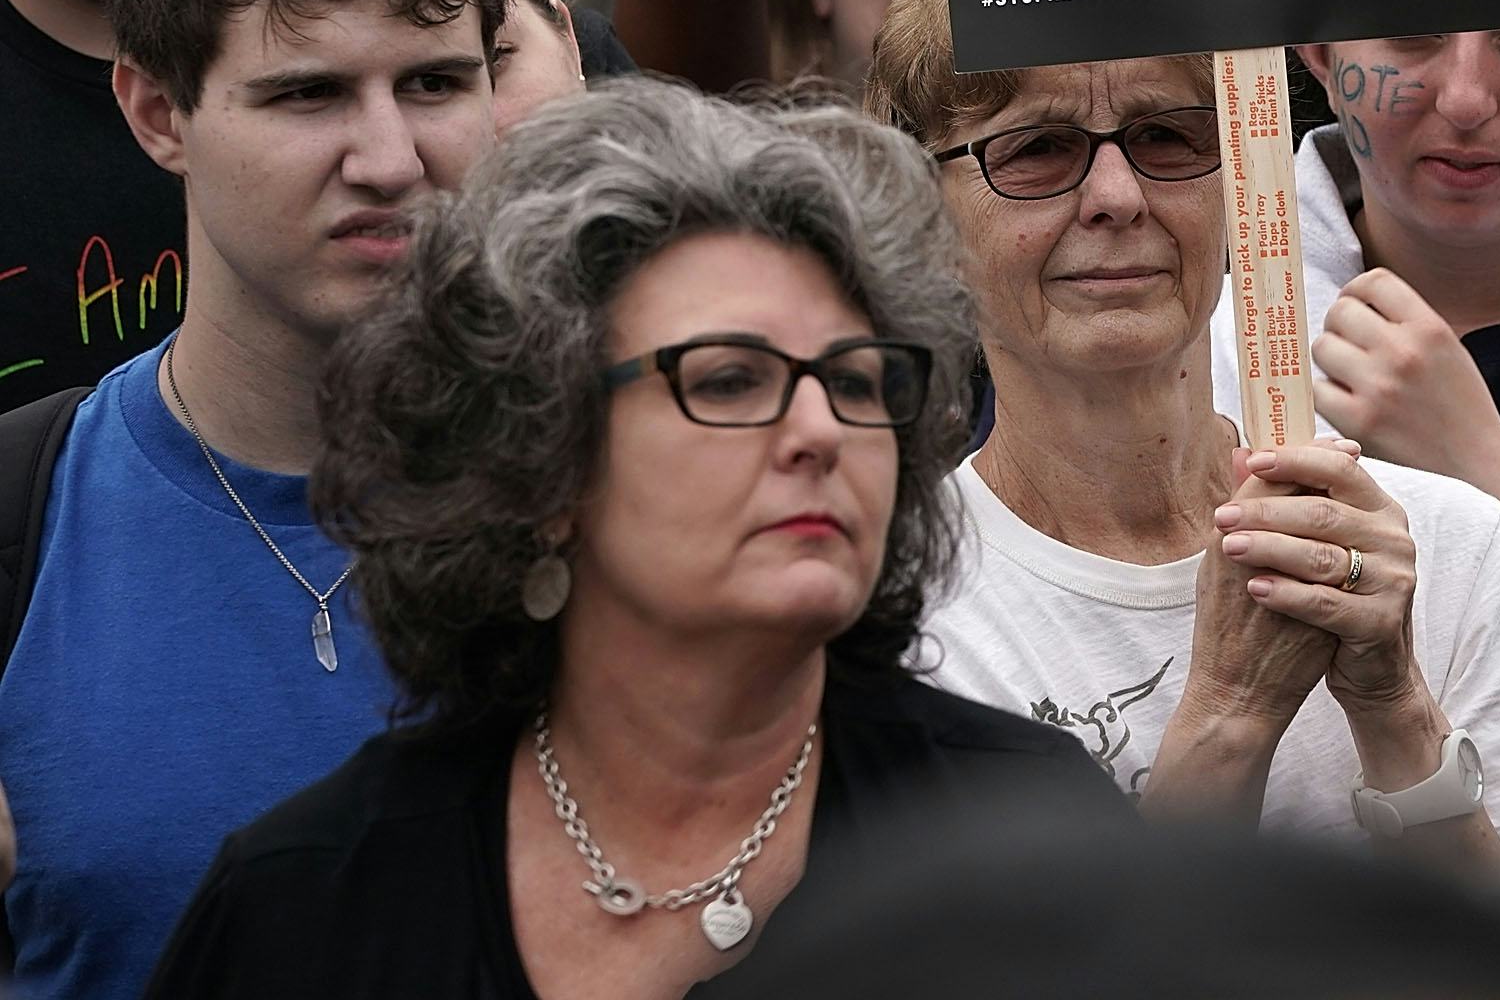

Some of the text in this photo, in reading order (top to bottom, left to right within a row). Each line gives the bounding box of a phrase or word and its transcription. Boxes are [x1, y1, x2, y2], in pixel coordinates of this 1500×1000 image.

[1249, 101, 1258, 127] Rags
[1255, 75, 1267, 126] Stir Sticks
[1266, 75, 1278, 126] Paint Kits
[1333, 54, 1426, 115] VOTE
[1222, 56, 1261, 378] Don't forget to pick up your painting supplies:
[1256, 194, 1268, 247] Paint Tray
[1269, 222, 1279, 247] Tape
[1275, 190, 1289, 246] Drop Cloth
[77, 235, 182, 344] Am
[1284, 270, 1299, 365] Paint Roller Cover
[1265, 306, 1279, 367] Paint Brush
[1276, 305, 1289, 366] Paint Roller
[1267, 386, 1285, 446] ainting?
